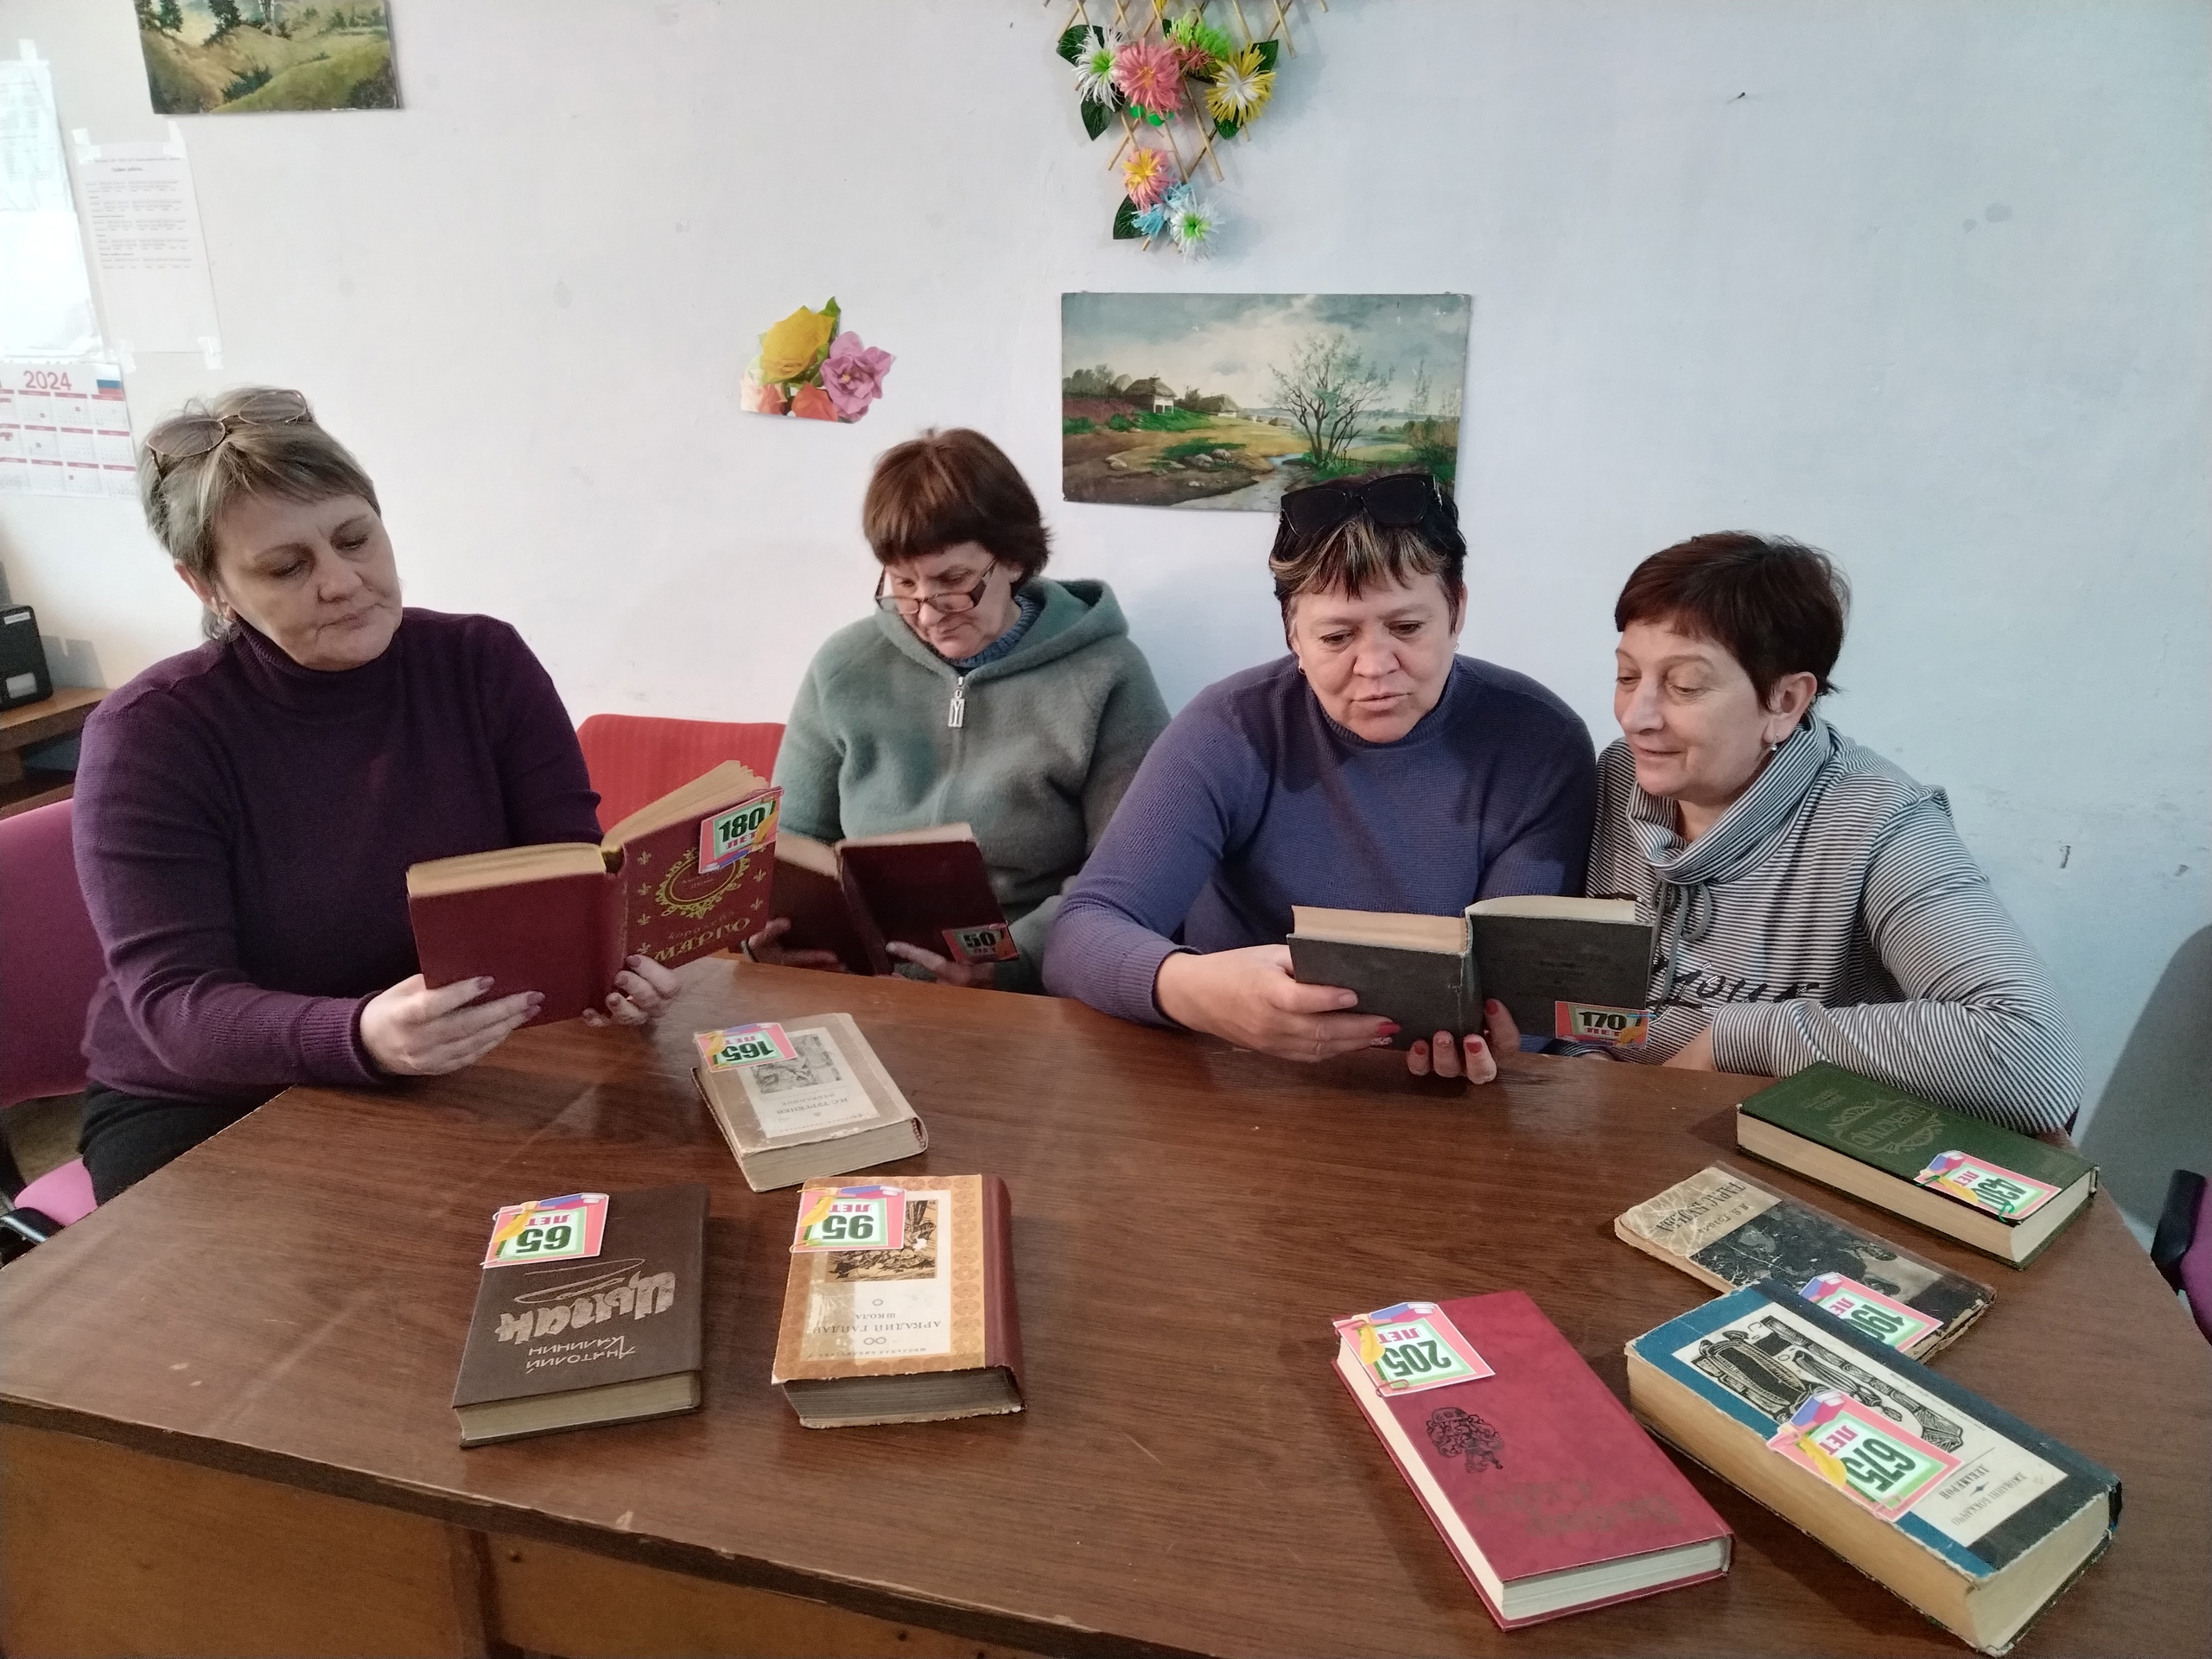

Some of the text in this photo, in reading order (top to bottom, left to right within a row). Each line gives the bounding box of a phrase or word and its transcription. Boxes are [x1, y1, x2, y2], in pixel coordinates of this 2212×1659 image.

[23, 370, 72, 391] 2024
[719, 807, 766, 842] 180
[726, 833, 757, 849] ЛЕТ
[963, 931, 996, 947] 50
[1579, 1011, 1627, 1030] 170
[721, 1039, 774, 1062] 165
[1953, 1170, 1979, 1186] ЛЕТ
[1701, 1182, 1746, 1206] ТАРАС
[1970, 1178, 2027, 1209] 430
[829, 1204, 871, 1212] ЛЕТ
[524, 1214, 570, 1227] ЛЕТ
[822, 1215, 874, 1240] 95
[516, 1225, 572, 1253] 65
[495, 1271, 676, 1344] Цыган
[874, 1321, 941, 1332] АРКАДИЙ
[1378, 1327, 1421, 1344] ЛЕТ
[1381, 1340, 1452, 1377] 205
[1817, 1425, 1859, 1456] ЛЕТ
[1840, 1438, 1916, 1492] 675
[1939, 1464, 1990, 1500] ДЕКАМЕРОН
[1951, 1497, 1992, 1526] БОККАЧЧО
